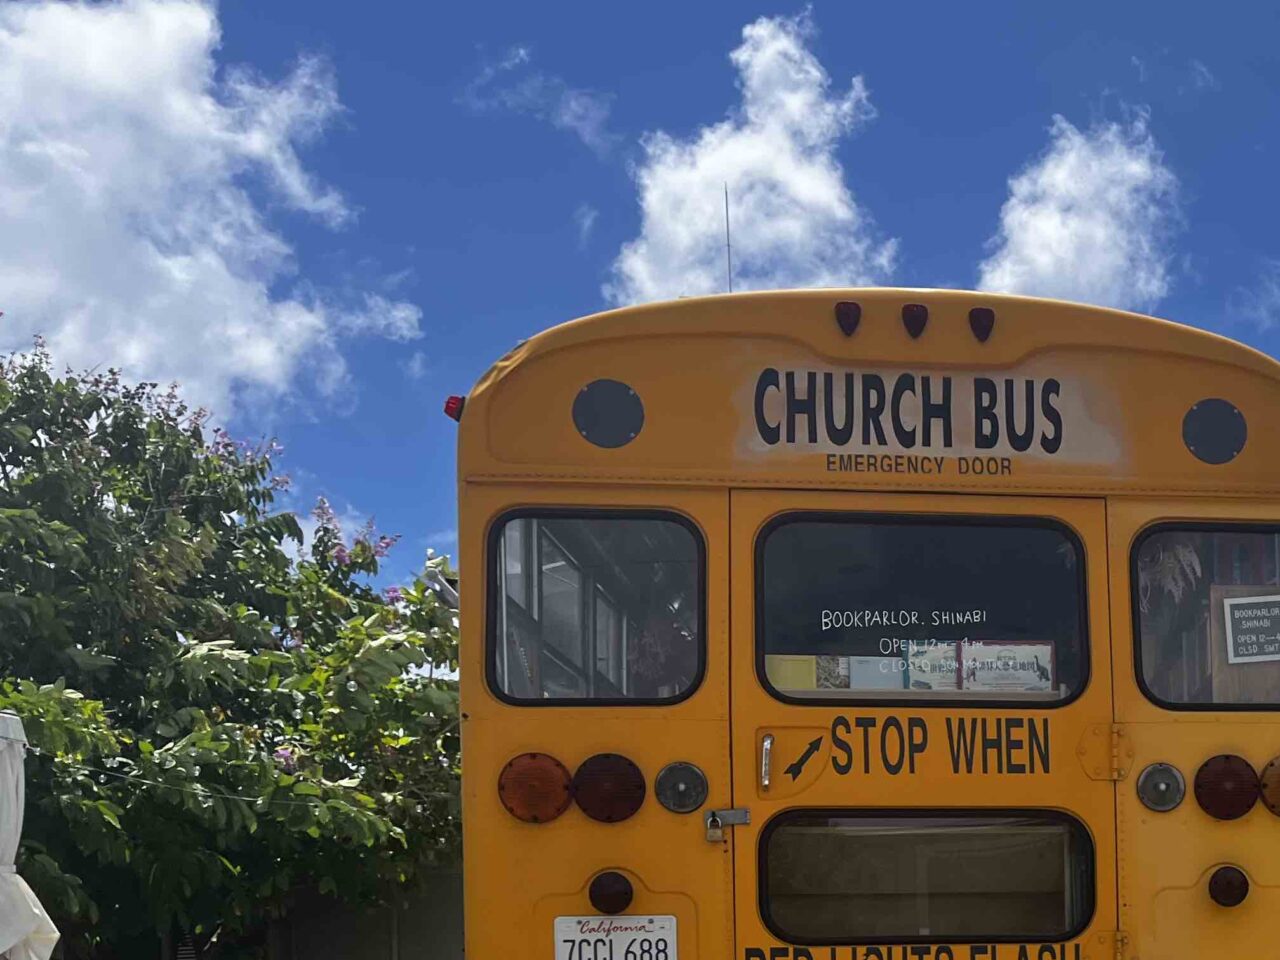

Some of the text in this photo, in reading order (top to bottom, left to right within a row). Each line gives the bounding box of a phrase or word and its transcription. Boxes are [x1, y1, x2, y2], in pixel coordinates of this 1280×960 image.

[754, 368, 1063, 455] CHURCH BUS
[826, 454, 1013, 476] EMERGENCY DOOR
[931, 609, 987, 626] SHINABI
[1234, 608, 1280, 618] BOOKPARLOR
[1241, 618, 1270, 629] SHINABI
[879, 638, 918, 655] OPEN
[1237, 634, 1256, 643] OPEN
[1239, 643, 1279, 655] CLSD SMT
[879, 659, 931, 674] CLOSED
[831, 715, 1051, 775] STOP WHEN
[579, 919, 650, 938] California
